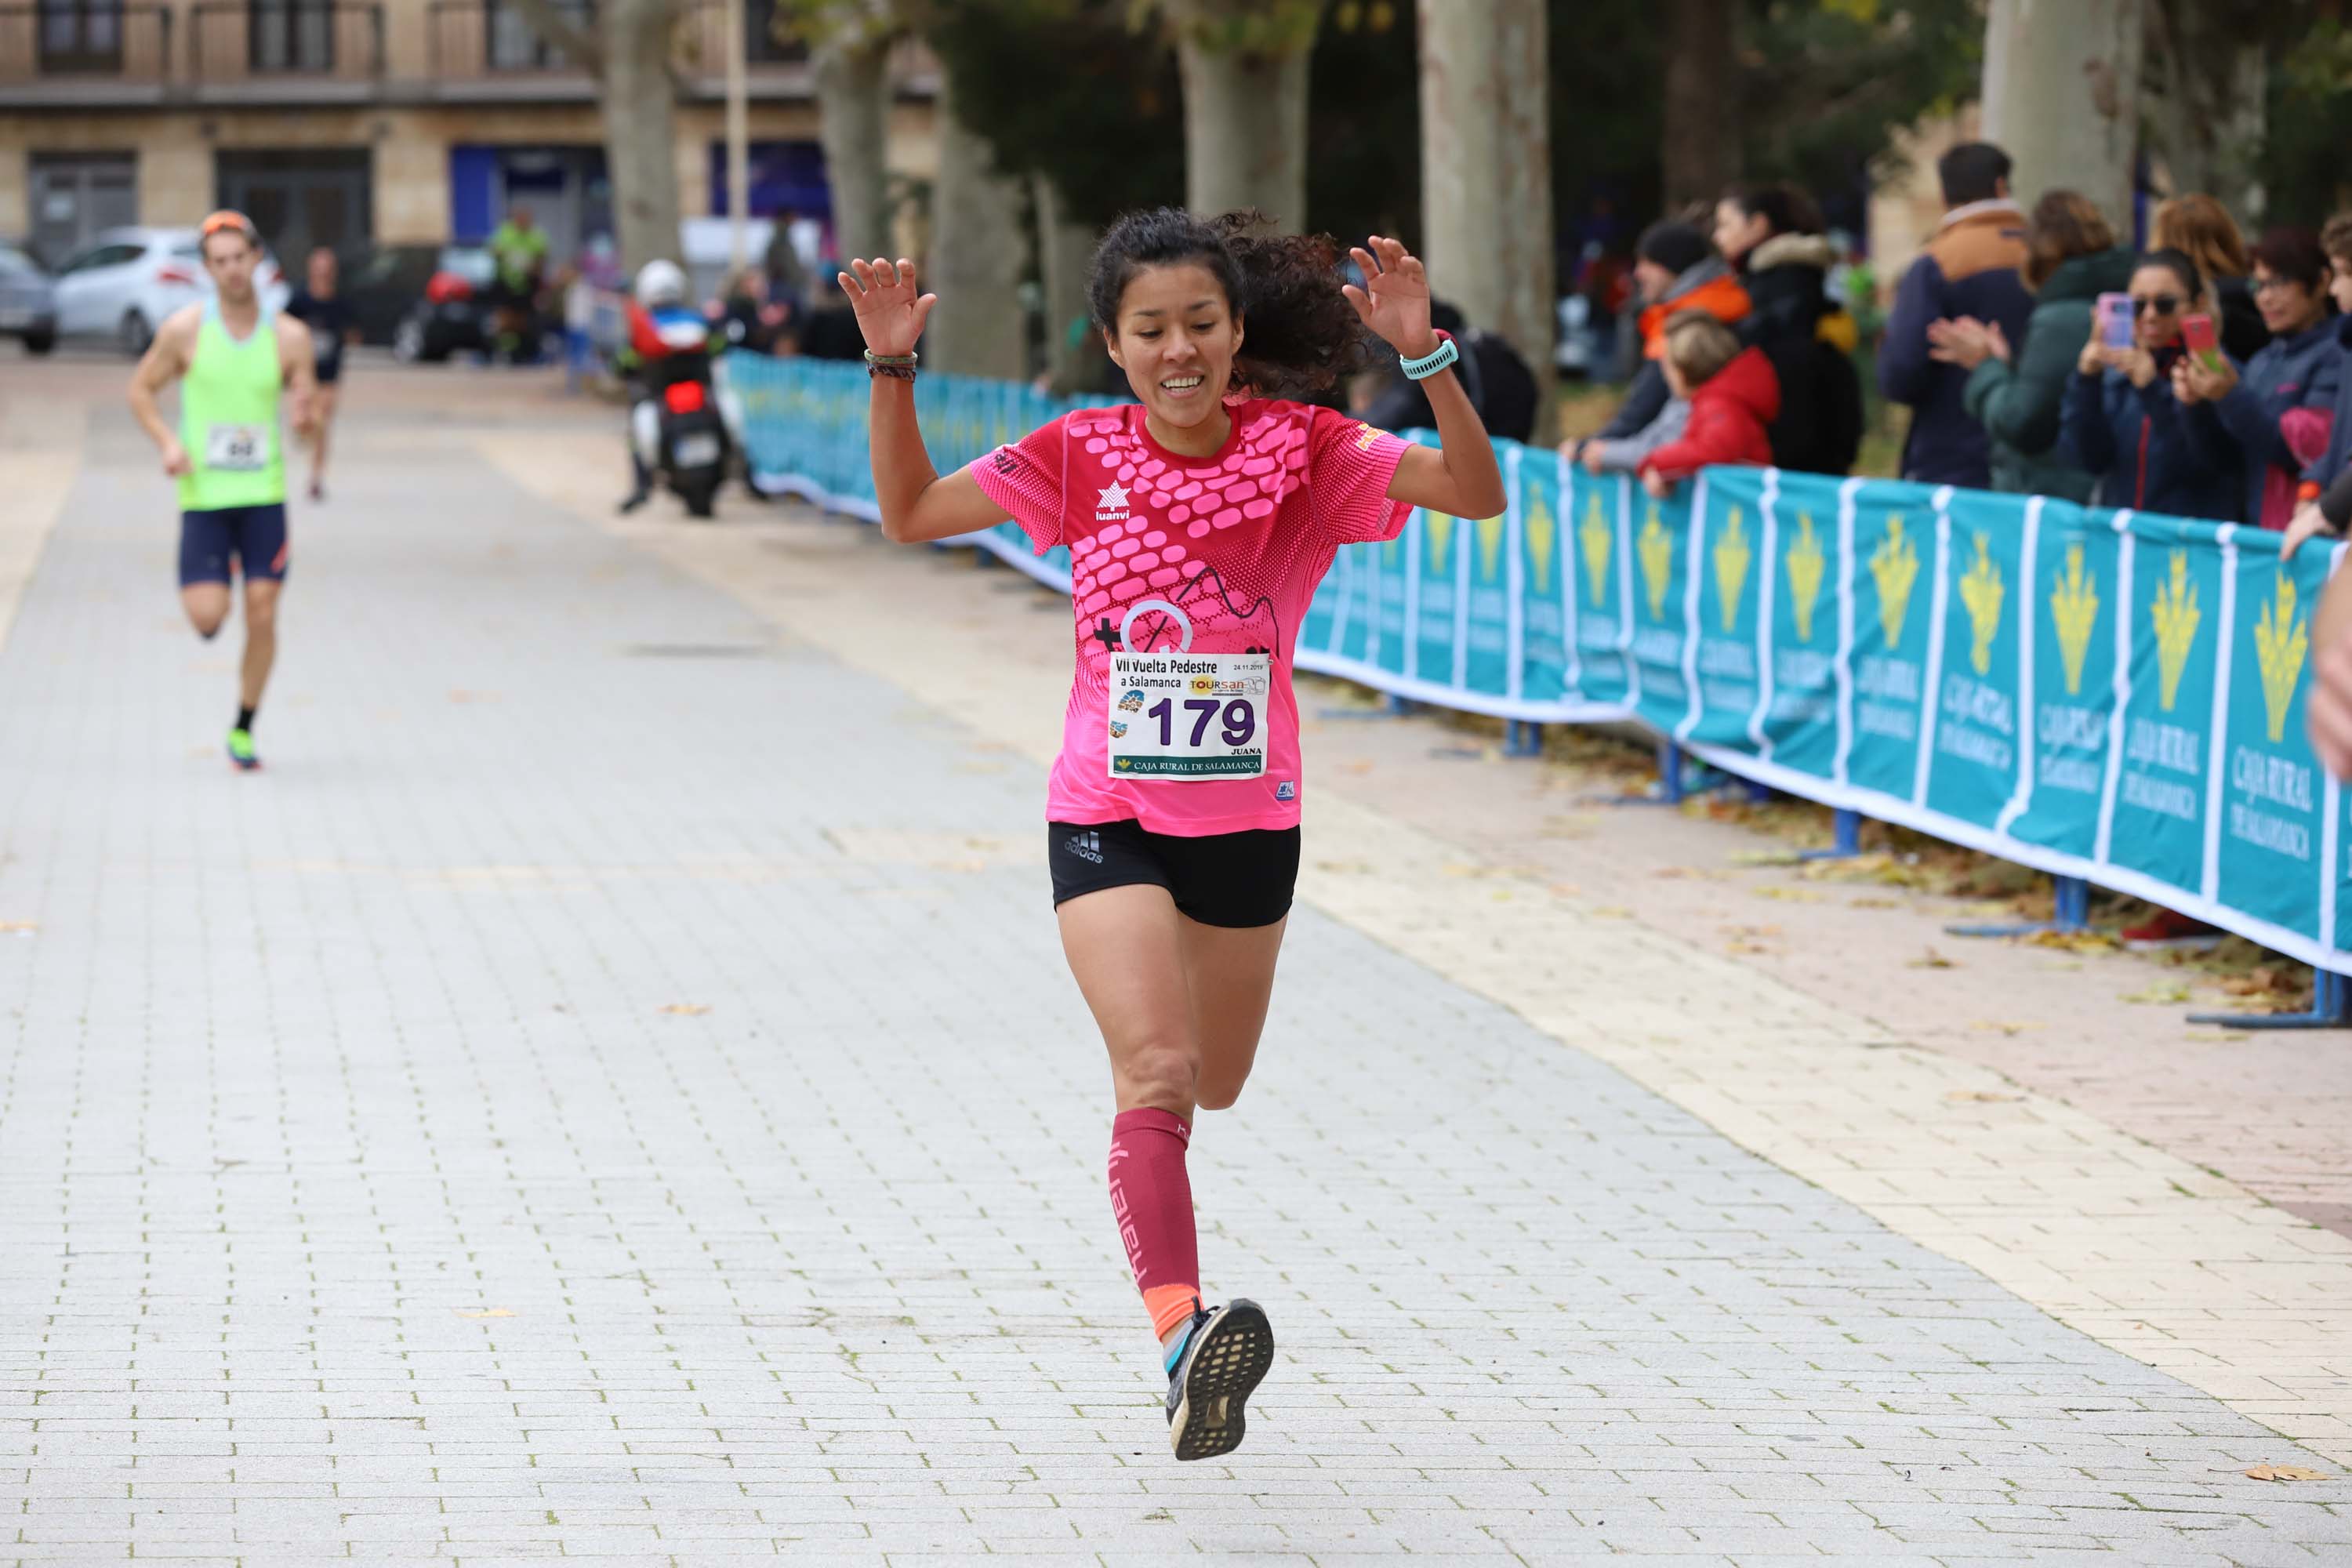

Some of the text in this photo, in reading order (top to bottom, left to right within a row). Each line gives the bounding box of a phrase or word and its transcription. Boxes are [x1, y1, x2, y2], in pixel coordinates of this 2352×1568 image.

[1095, 510, 1130, 521] luanvi
[1132, 659, 1167, 673] Vuelta
[1171, 659, 1218, 673] Pedestre
[1121, 676, 1181, 688] a Salamanca
[1149, 698, 1255, 746] 179
[1134, 762, 1157, 771] CAJA
[1160, 762, 1189, 771] RURAL
[1205, 761, 1260, 771] SALAMANCA
[1065, 840, 1103, 863] adidas
